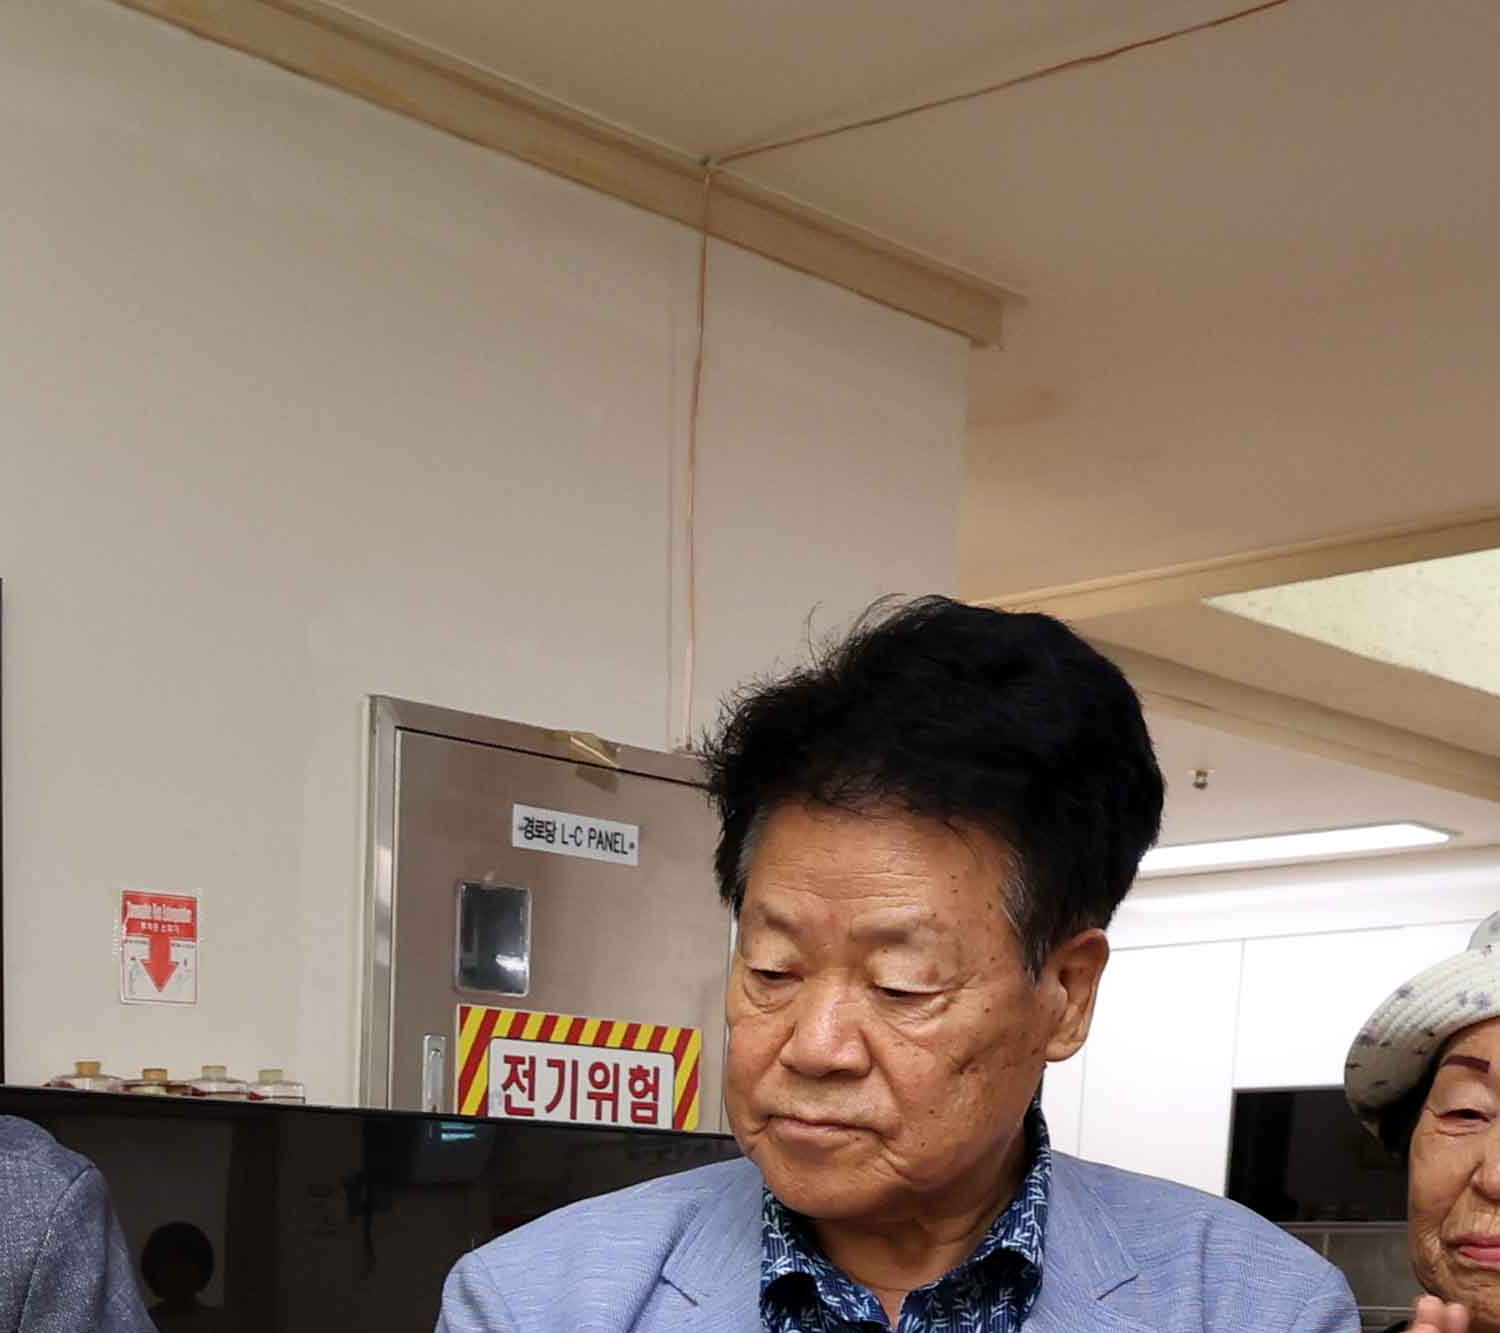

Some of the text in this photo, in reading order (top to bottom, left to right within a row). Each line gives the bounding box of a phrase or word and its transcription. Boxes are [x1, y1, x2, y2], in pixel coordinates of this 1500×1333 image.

[523, 816, 628, 855] 경로당 L-C PANEL
[502, 1055, 660, 1125] 전기위험
